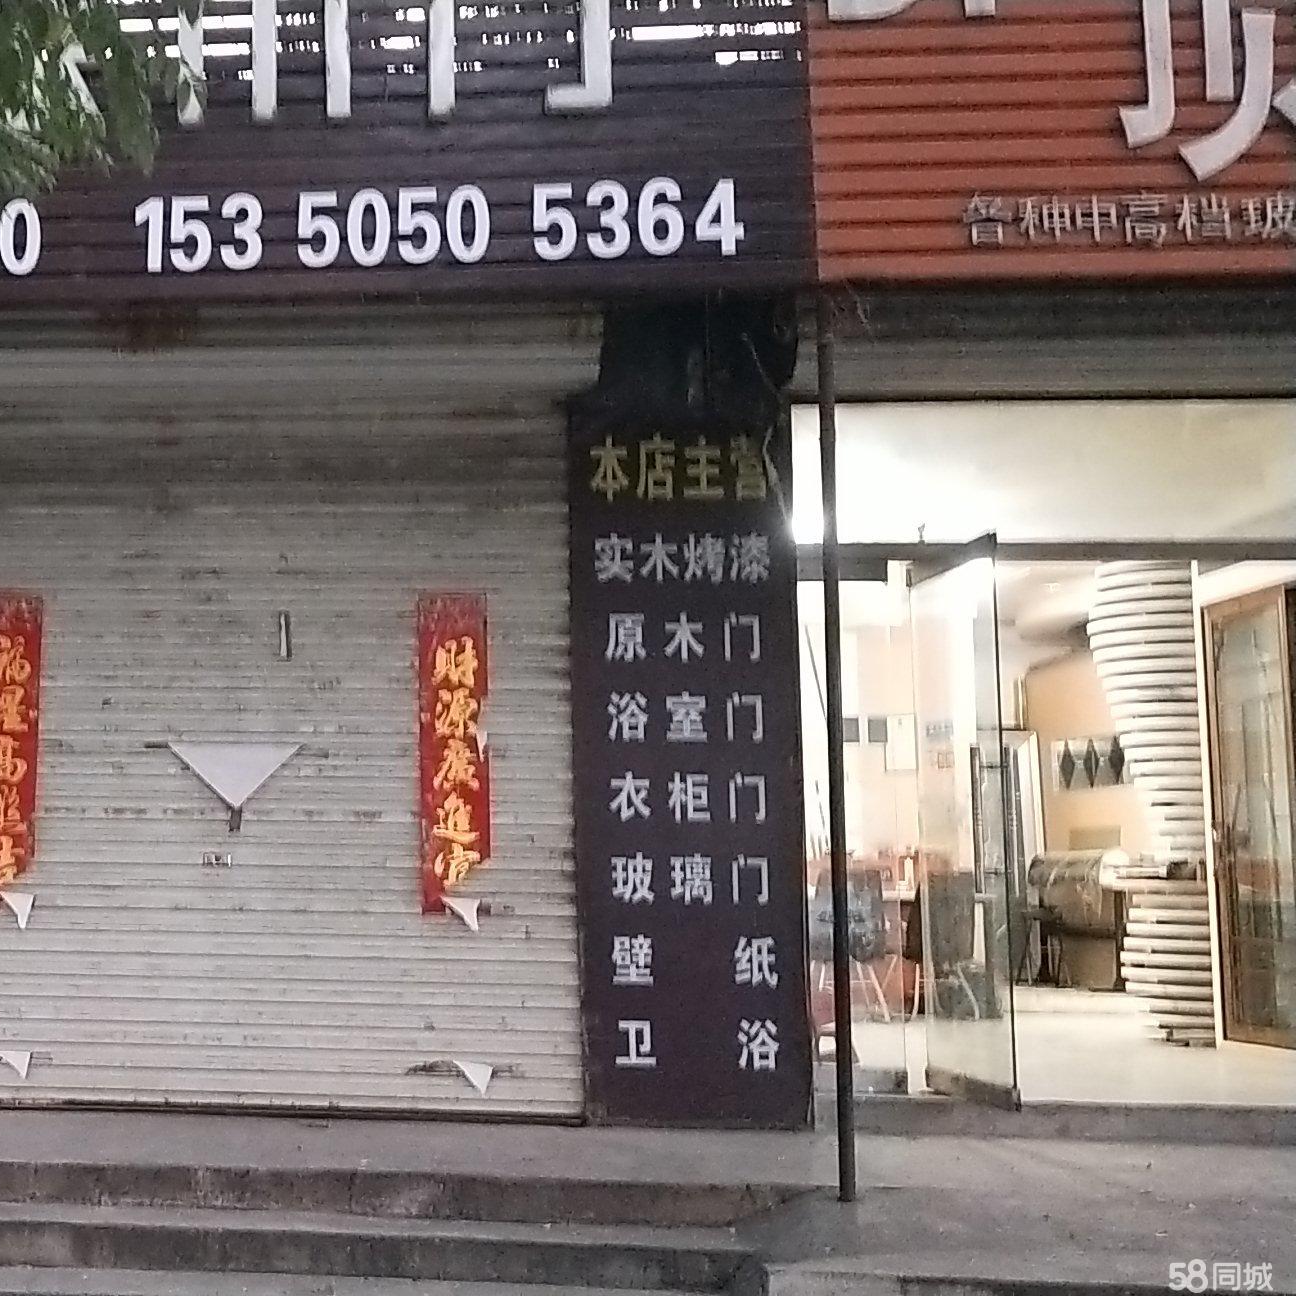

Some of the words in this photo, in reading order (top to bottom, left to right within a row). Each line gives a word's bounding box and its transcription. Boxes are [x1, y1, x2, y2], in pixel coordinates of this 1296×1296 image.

[134, 192, 264, 274] 153
[296, 184, 492, 269] 5050
[531, 175, 746, 261] 5364
[589, 432, 767, 502] 本店主营
[594, 532, 771, 584] 实木烤漆
[604, 611, 761, 664] 原木门
[607, 691, 764, 744] 浴室门
[609, 771, 768, 825] 衣柜门
[611, 852, 770, 906] 玻璃门
[612, 934, 779, 990] 壁纸
[615, 1018, 781, 1072] 卫浴
